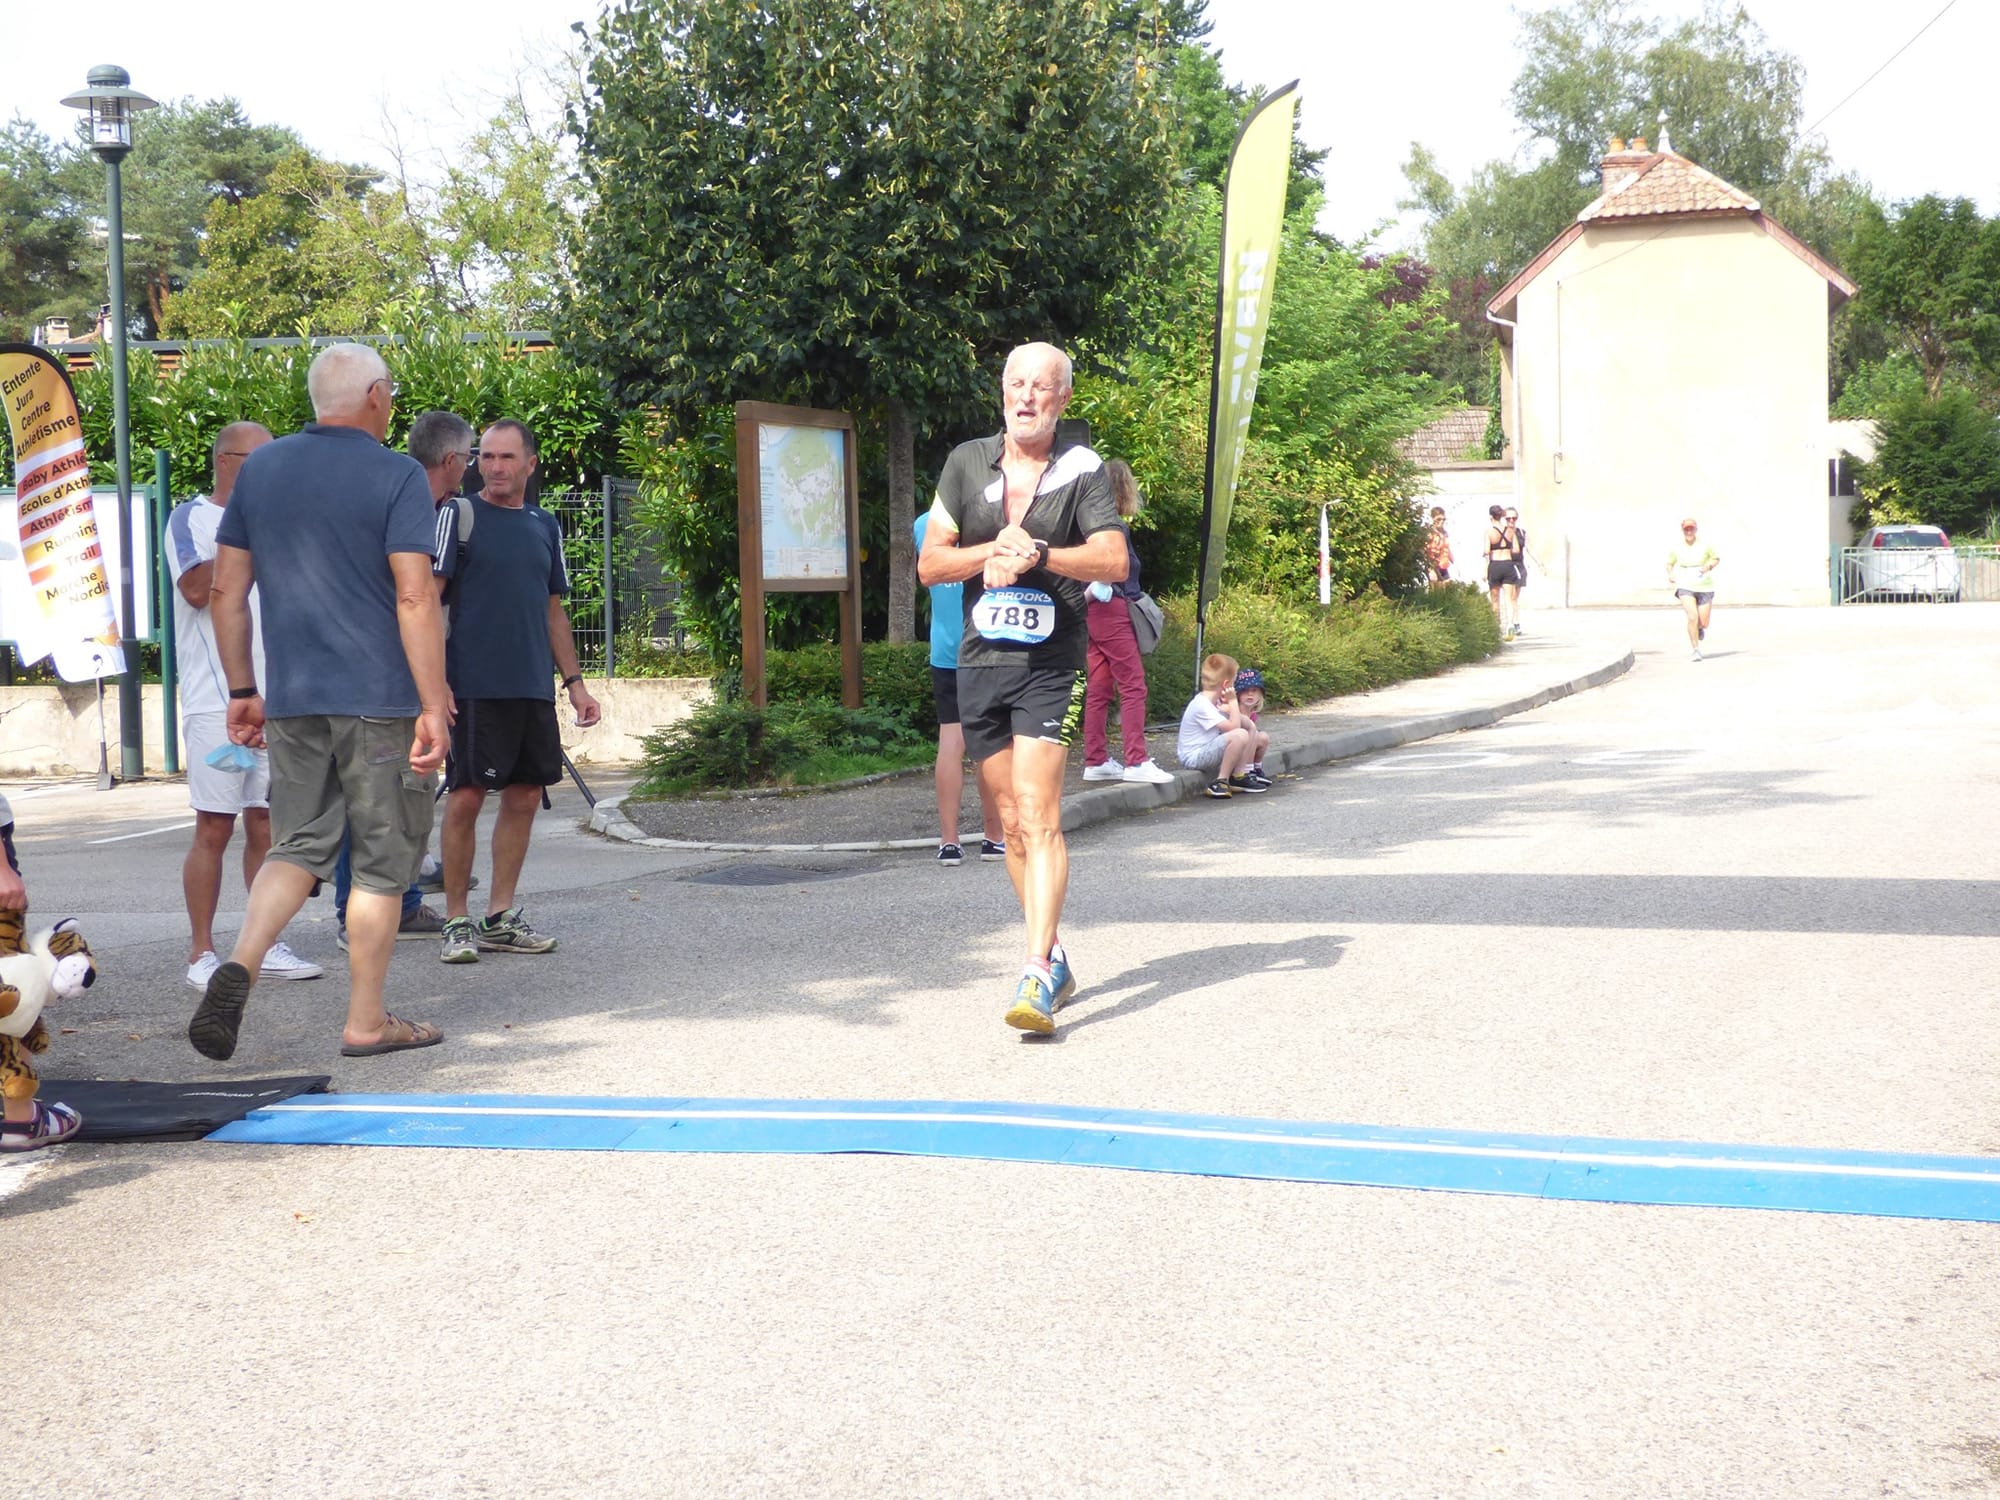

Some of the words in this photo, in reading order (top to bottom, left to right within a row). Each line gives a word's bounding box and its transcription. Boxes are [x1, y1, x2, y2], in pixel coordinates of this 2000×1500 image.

[2, 361, 41, 395] Entente
[16, 389, 34, 411] Jura
[21, 401, 51, 431] Centre
[16, 415, 76, 459] Athlétisme
[23, 471, 48, 491] Baby
[21, 495, 51, 516] Ecole
[44, 523, 98, 552] Running
[65, 546, 96, 567] Trail
[45, 572, 97, 600] Marche
[995, 591, 1052, 603] BROOKS
[988, 607, 1040, 630] 788
